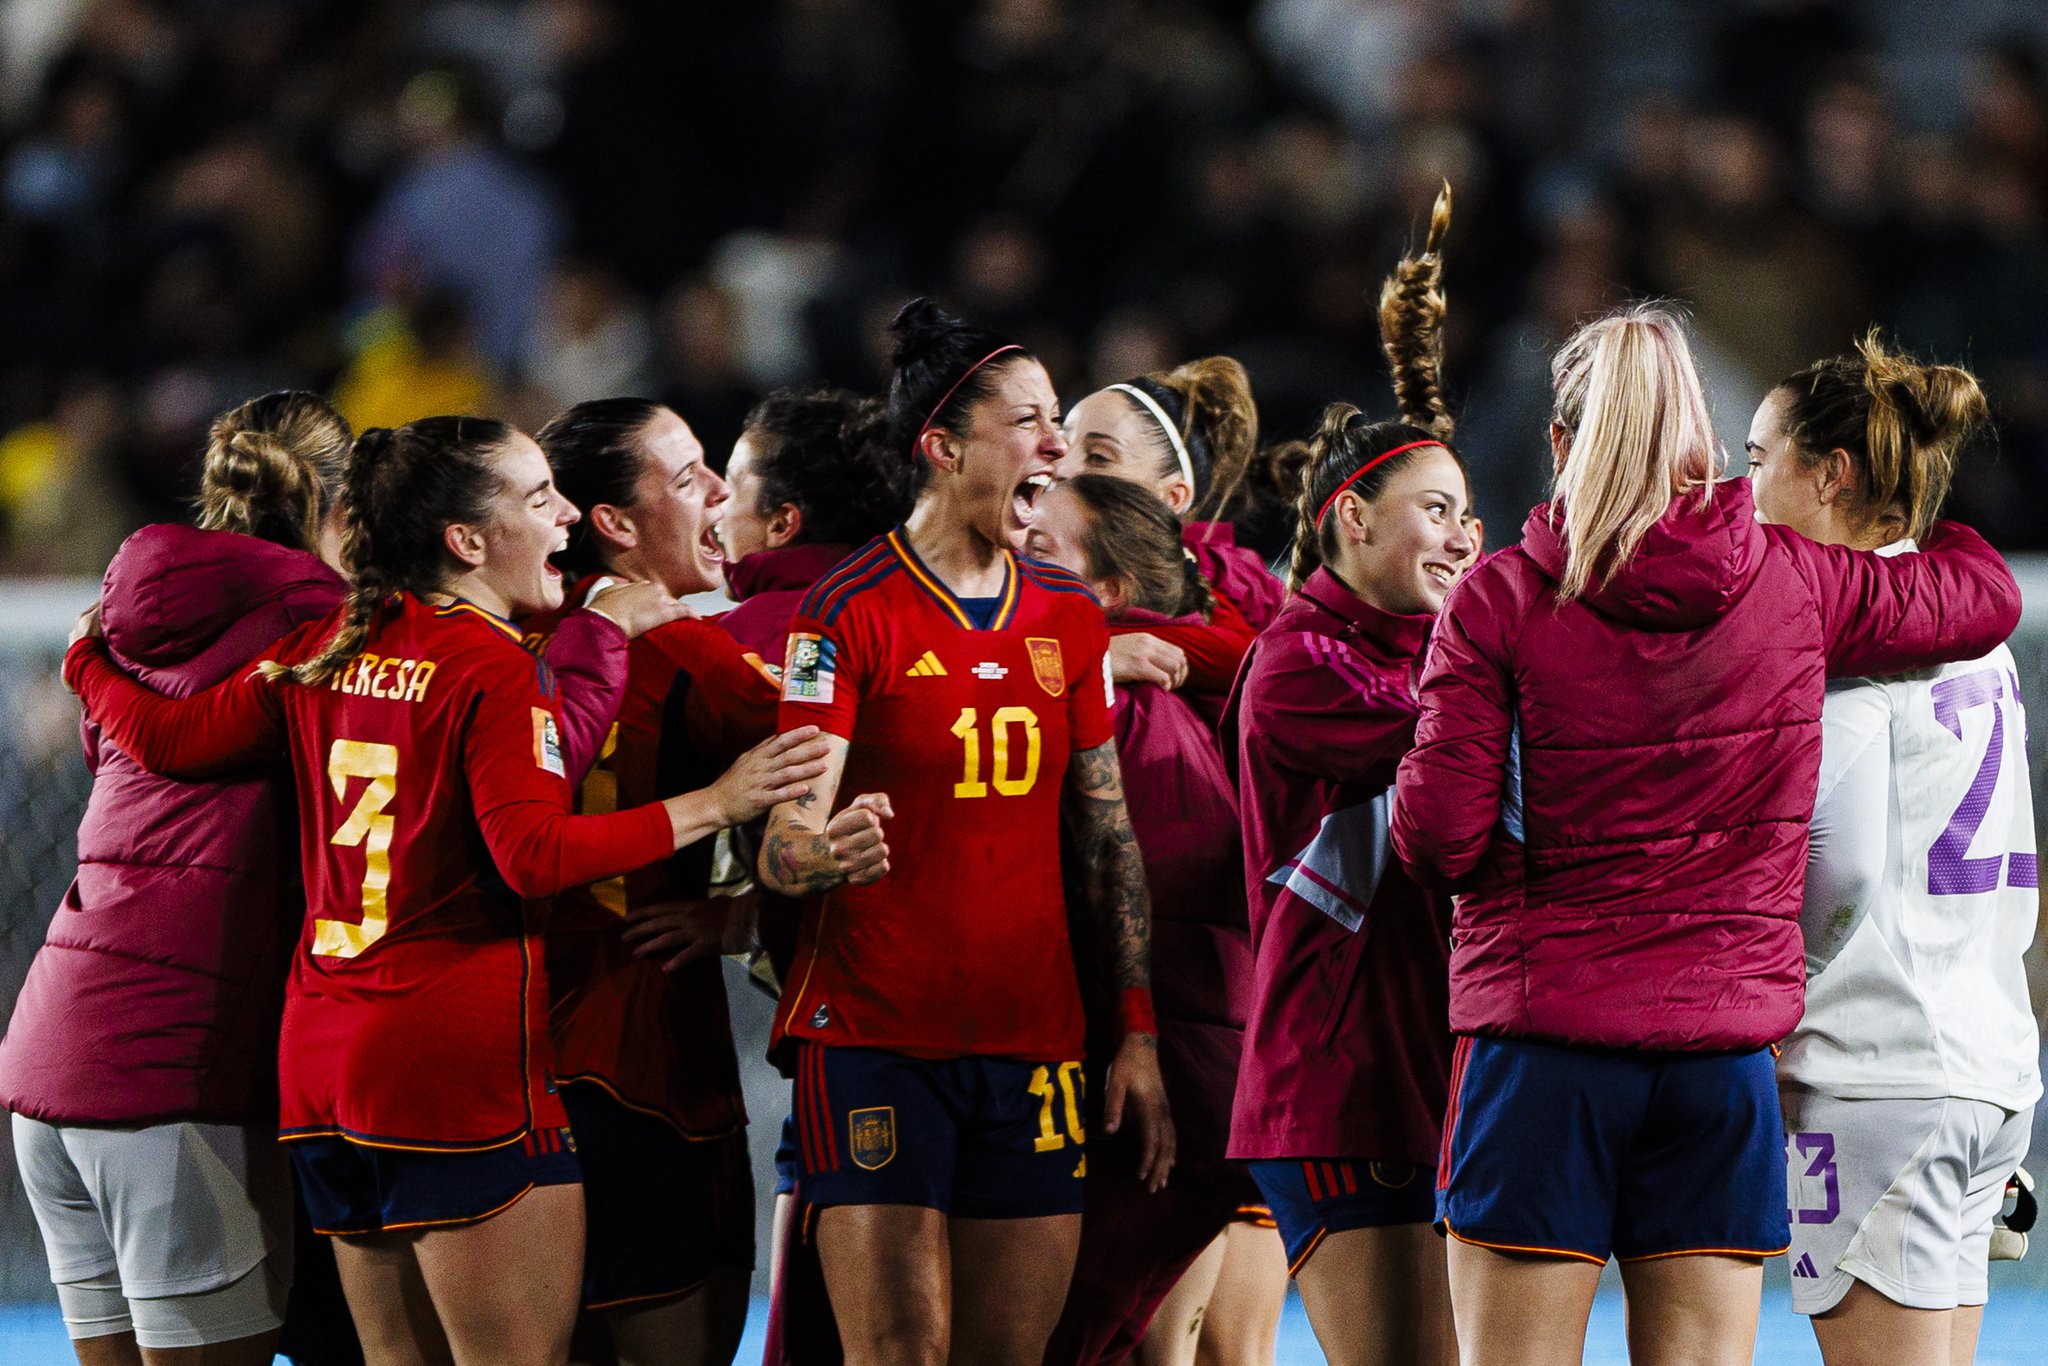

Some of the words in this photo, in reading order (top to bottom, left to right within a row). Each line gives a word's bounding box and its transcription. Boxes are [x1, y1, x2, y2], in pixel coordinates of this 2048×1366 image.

[950, 706, 1041, 798] 10
[1928, 666, 2040, 895] 2
[312, 738, 398, 959] 3
[1783, 1132, 1841, 1225] 3
